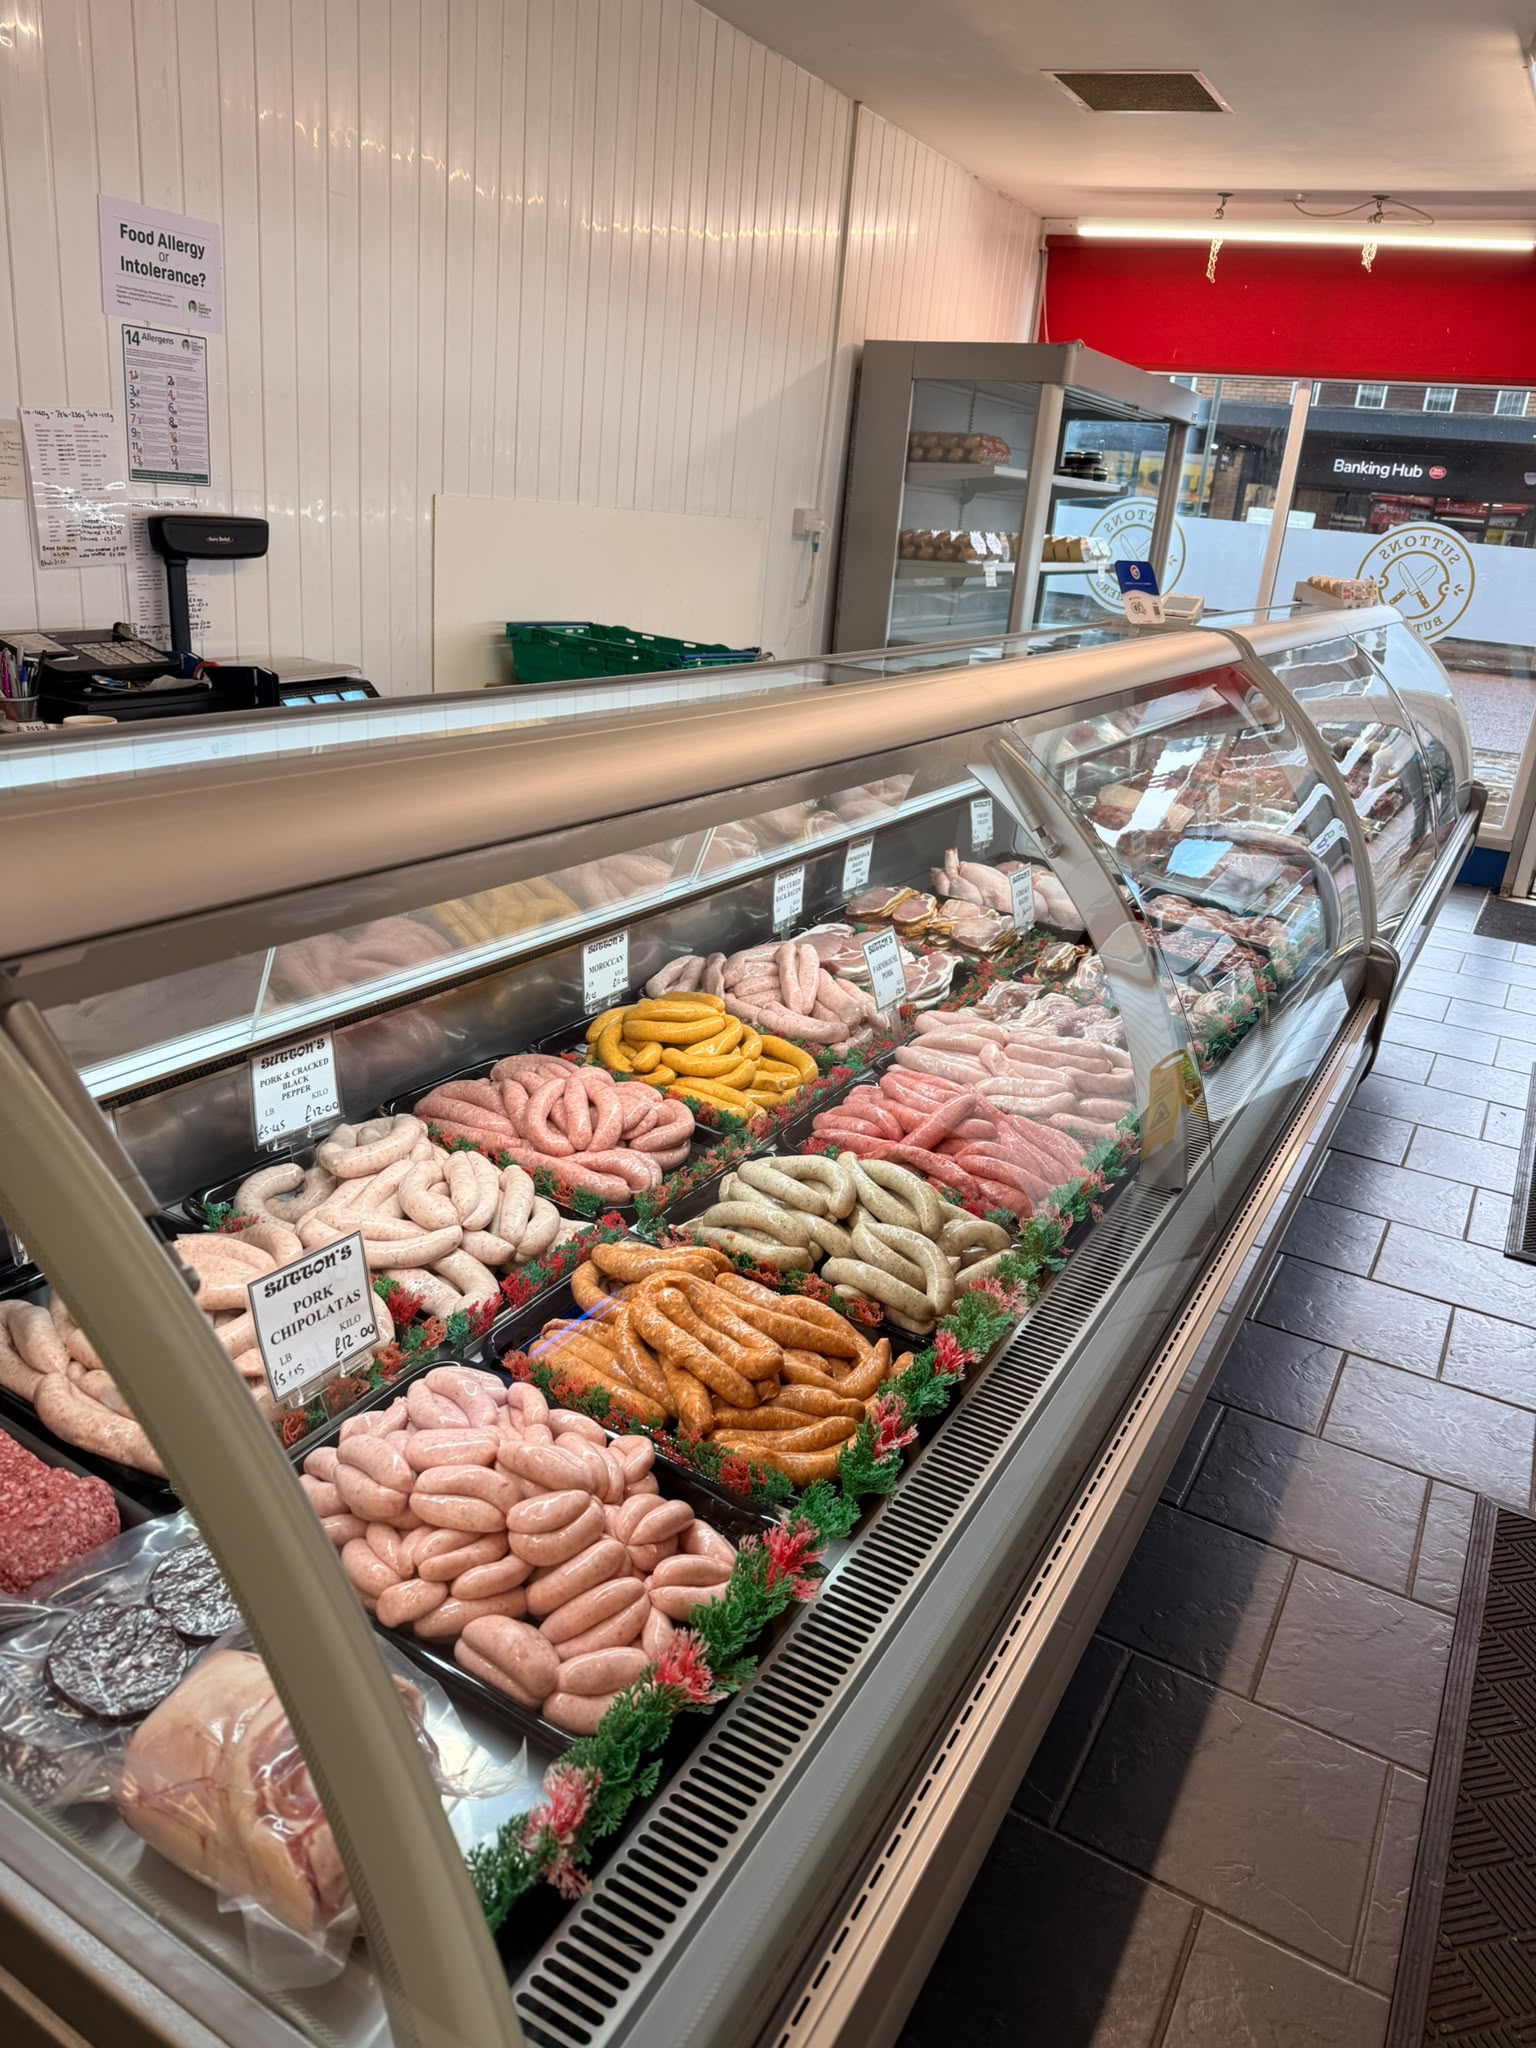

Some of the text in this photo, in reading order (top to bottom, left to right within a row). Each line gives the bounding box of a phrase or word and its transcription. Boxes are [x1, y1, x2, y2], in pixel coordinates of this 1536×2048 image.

[120, 223, 205, 260] Food Allergy
[159, 252, 169, 262] or
[121, 255, 206, 287] Intolerance?
[125, 329, 174, 346] 14 Allergens
[129, 384, 135, 395] 3
[129, 399, 135, 409] 5
[130, 413, 136, 423] 7
[168, 417, 174, 427] 8
[131, 428, 136, 438] 9
[1333, 459, 1390, 478] Banking
[1392, 463, 1423, 478] Hub
[588, 934, 624, 954] SUTTON'S
[589, 954, 624, 974] MOROCCAN
[261, 1038, 325, 1069] SUTTON'S
[260, 1057, 329, 1088] PORK & CRACKED
[282, 1074, 310, 1090] BLACK
[281, 1084, 312, 1101] PEPPER
[311, 1088, 329, 1100] KILO
[265, 1107, 275, 1117] LB
[264, 1244, 352, 1298] SUTTON'S
[293, 1283, 334, 1315] PORK
[270, 1289, 361, 1346] CHIPOLATAS
[339, 1313, 362, 1332] KILO
[279, 1352, 293, 1366] LB
